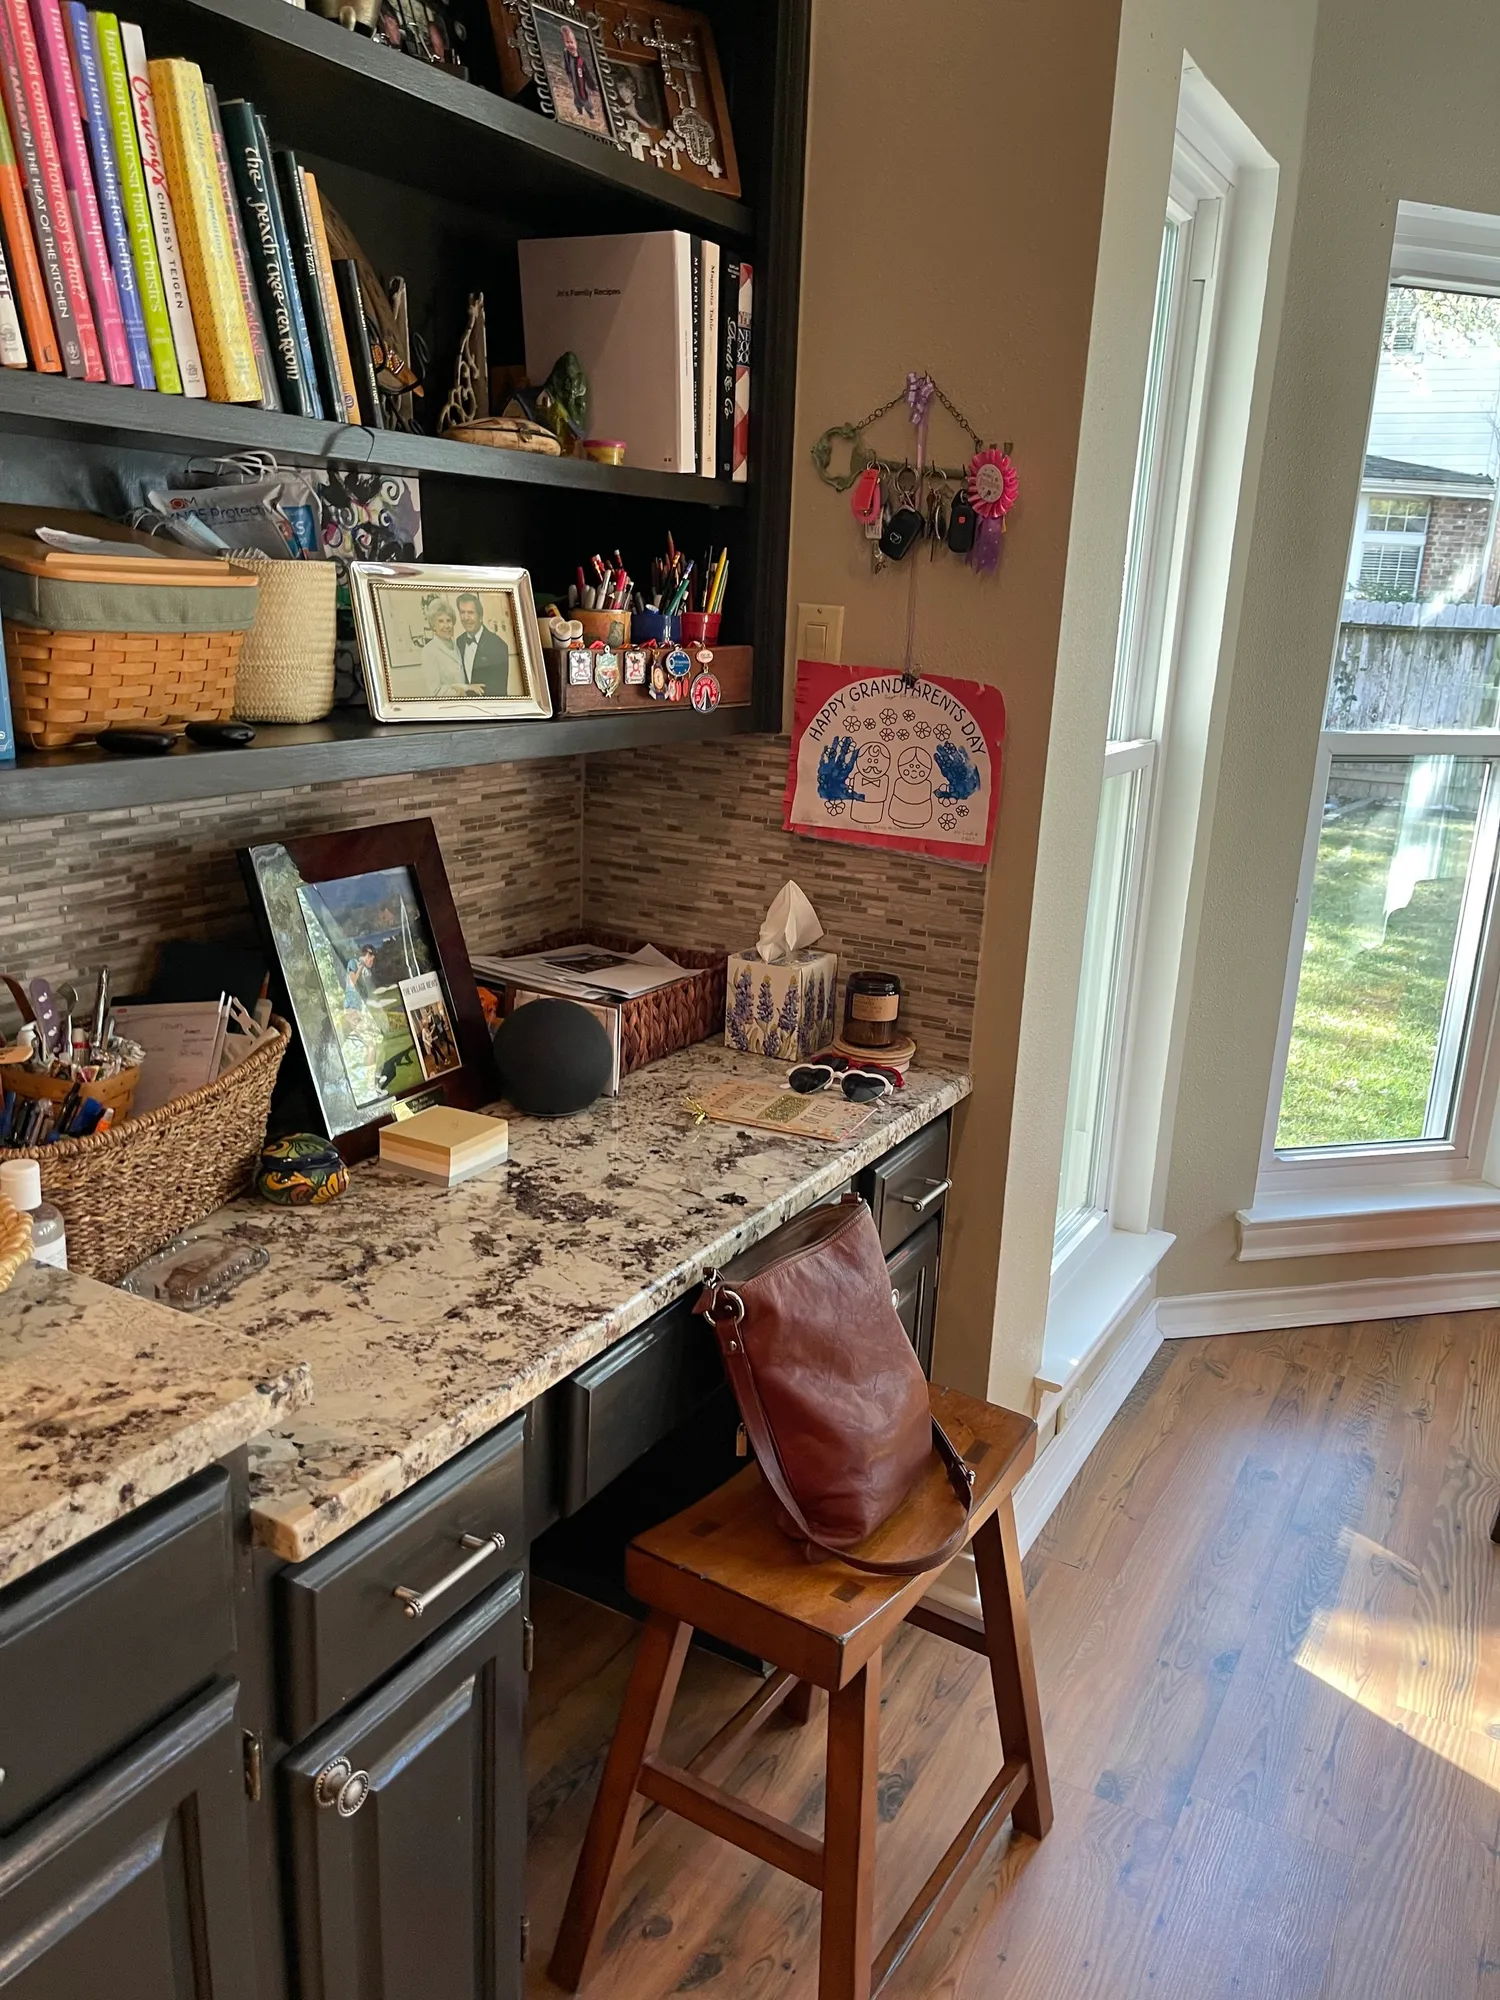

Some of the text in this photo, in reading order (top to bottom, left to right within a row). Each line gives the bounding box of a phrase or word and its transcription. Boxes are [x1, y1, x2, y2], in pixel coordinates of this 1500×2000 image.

[29, 80, 54, 157] contessa
[22, 131, 31, 145] IN
[131, 76, 172, 201] Cravings
[26, 151, 38, 174] THE
[47, 161, 64, 197] how
[104, 29, 163, 312] barefoot contessa back to basics
[31, 178, 46, 211] HEAT
[39, 214, 51, 233] OF
[51, 200, 69, 234] easy
[44, 237, 57, 259] THE
[156, 193, 182, 308] CHRISSY TEIGEN
[49, 263, 69, 318] KITCHEN
[809, 694, 848, 742] HAPPY
[961, 721, 986, 756] DAY
